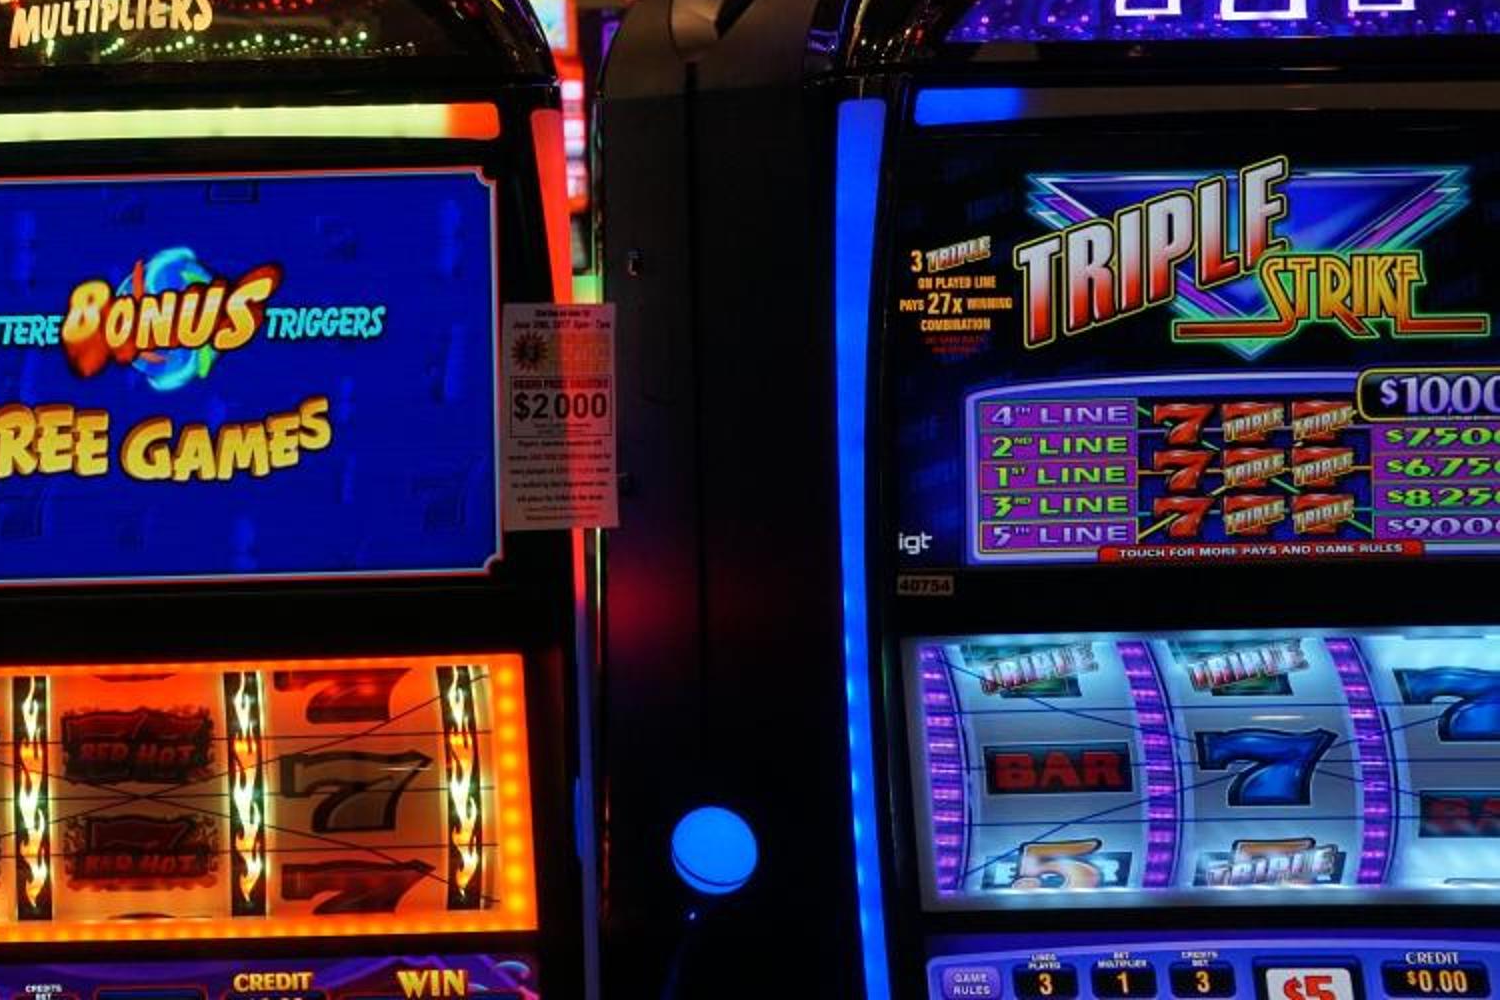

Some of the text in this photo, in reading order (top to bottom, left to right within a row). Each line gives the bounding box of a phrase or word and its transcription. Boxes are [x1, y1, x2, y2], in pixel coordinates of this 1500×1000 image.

[911, 236, 991, 273] 3 TRIPLE
[1013, 156, 1288, 349] TRIPLE
[936, 276, 971, 289] PLAYED
[974, 276, 996, 288] LINE
[900, 300, 924, 311] PAYS
[928, 292, 962, 314] 27x
[63, 268, 280, 364] BONUS
[265, 305, 386, 341] TRIGGERS
[921, 318, 991, 331] COMBINATION
[1041, 406, 1128, 422] LINE
[1224, 407, 1353, 442] TRIPLE TRIPLE
[122, 396, 331, 483] GAMES
[1039, 437, 1128, 454] LINE
[1386, 427, 1500, 447] $7,50
[1038, 466, 1126, 484] LINE
[1224, 453, 1354, 488] TRIPLE TRIPLE
[1387, 458, 1500, 477] $6,75
[1040, 496, 1128, 514] LINE
[1387, 488, 1500, 507] $8,25
[1224, 499, 1354, 534] TRIPLE TRIPLE
[898, 531, 933, 555] igt
[1039, 525, 1128, 542] LINE
[1120, 544, 1403, 558] TOUCH FOR MORE PAYS AND GAME RULES
[995, 728, 1338, 807] BAR 7
[136, 744, 195, 762] HOT
[281, 749, 433, 832] 7
[1207, 844, 1338, 887] TRIPLE
[1405, 952, 1459, 964] CREDIT
[233, 972, 314, 992] CREDIT
[397, 970, 467, 998] WIN
[953, 973, 988, 983] GAME
[1039, 973, 1052, 995] 3
[1117, 972, 1128, 993] 1
[1196, 971, 1210, 993] 3
[1283, 976, 1336, 1000] $5
[1407, 970, 1468, 993] $0.00
[954, 985, 990, 995] RULES
